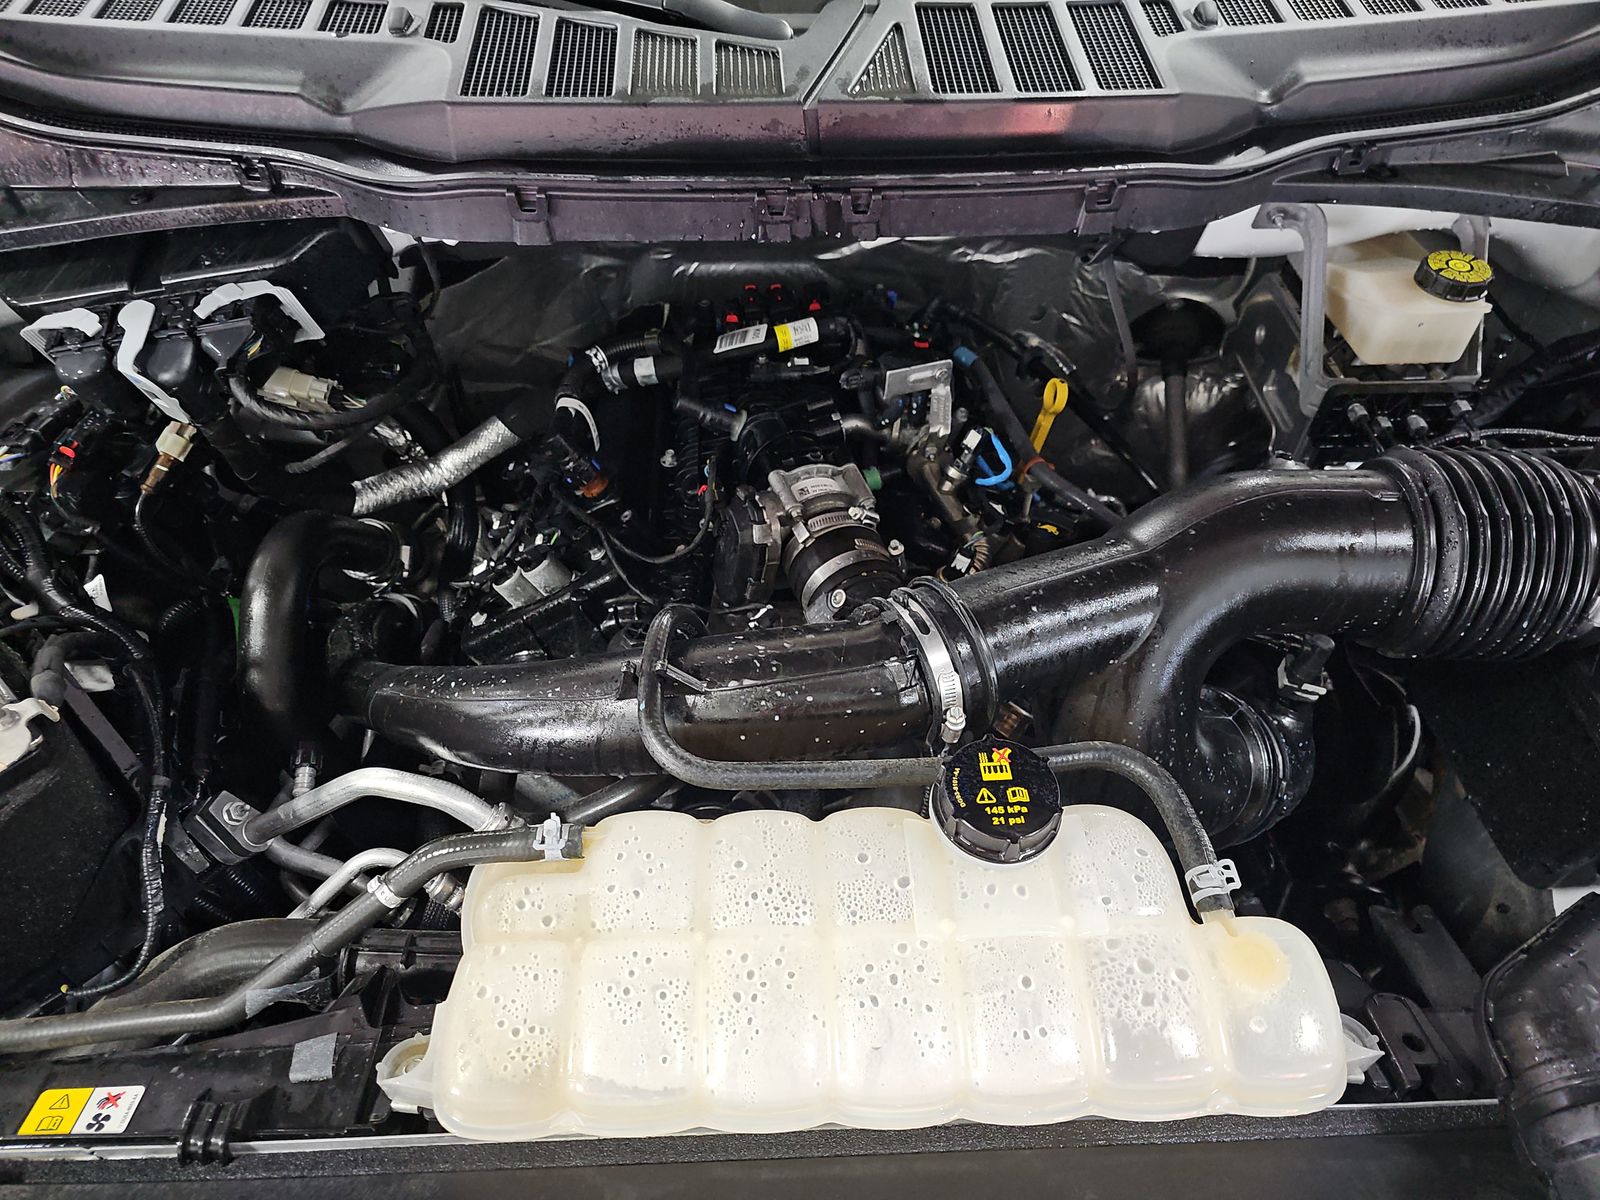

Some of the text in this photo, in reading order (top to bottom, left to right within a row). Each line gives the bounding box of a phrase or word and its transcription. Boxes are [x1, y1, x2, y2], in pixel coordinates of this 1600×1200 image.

[985, 805, 1028, 814] 145 kPa
[991, 816, 1025, 826] 21 psi
